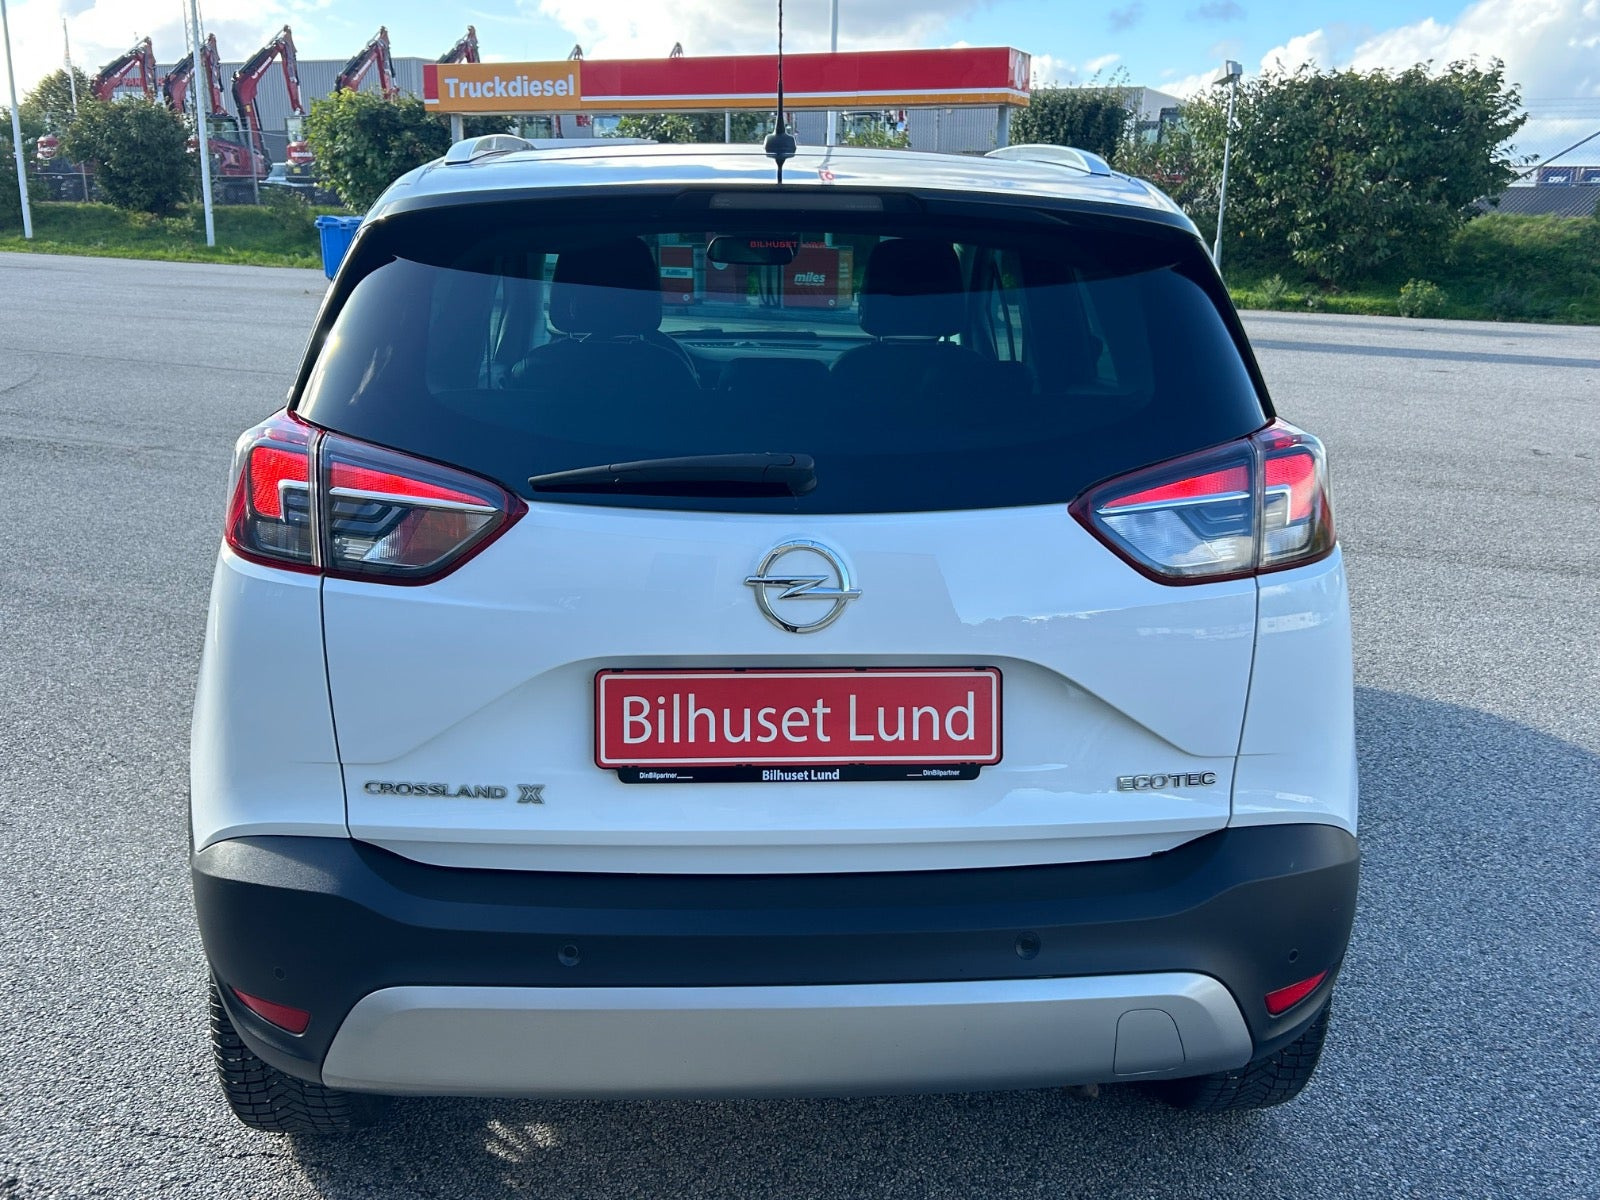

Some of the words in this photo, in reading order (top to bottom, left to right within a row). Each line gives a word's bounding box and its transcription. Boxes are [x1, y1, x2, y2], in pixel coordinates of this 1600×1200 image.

[444, 74, 575, 98] Truckdiesel
[794, 271, 826, 283] miles
[622, 693, 831, 745] Bilhuset
[848, 691, 975, 741] Lund
[762, 769, 809, 781] Bilhuset
[810, 768, 840, 780] Lund
[1117, 770, 1217, 792] ECOTEC
[364, 780, 508, 800] CROSSLAND
[516, 784, 545, 805] X
